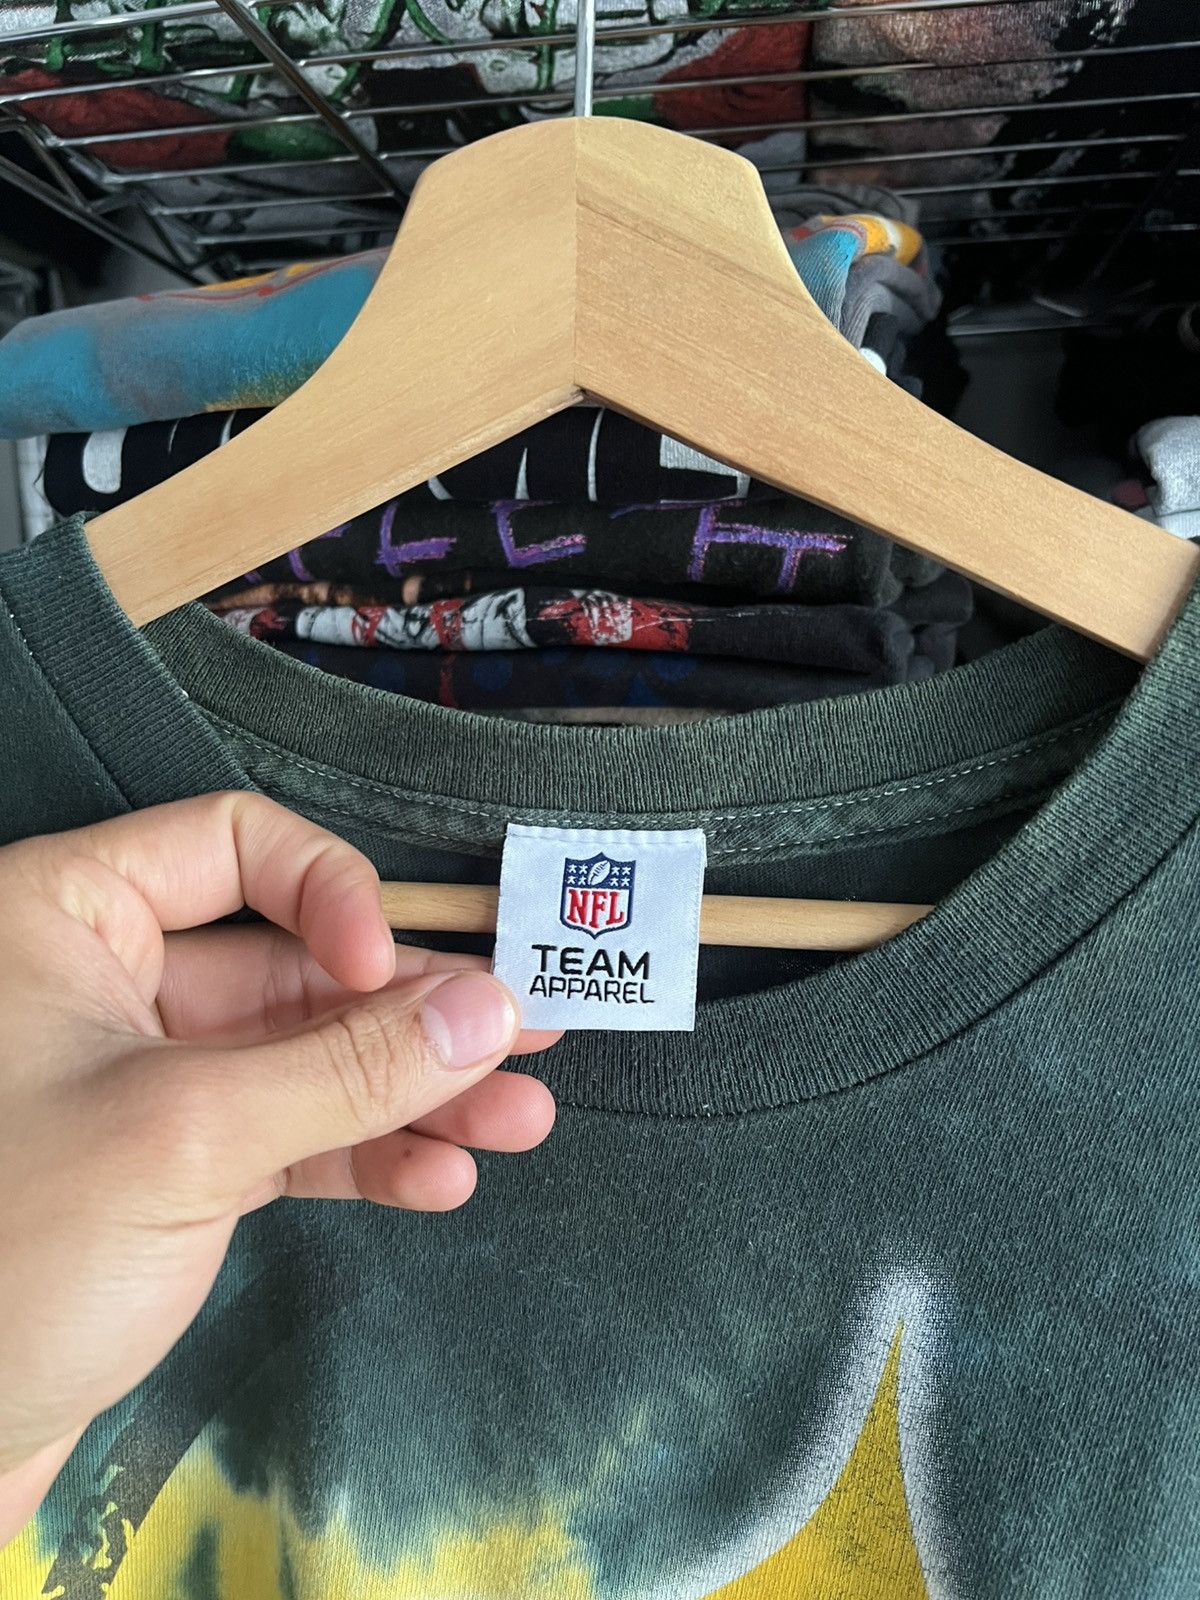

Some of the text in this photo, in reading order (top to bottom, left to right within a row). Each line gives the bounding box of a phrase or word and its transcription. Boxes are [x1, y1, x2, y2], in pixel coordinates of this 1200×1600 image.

[567, 889, 625, 929] NFL
[531, 944, 650, 980] TEAM
[529, 975, 655, 1004] APPAREL
